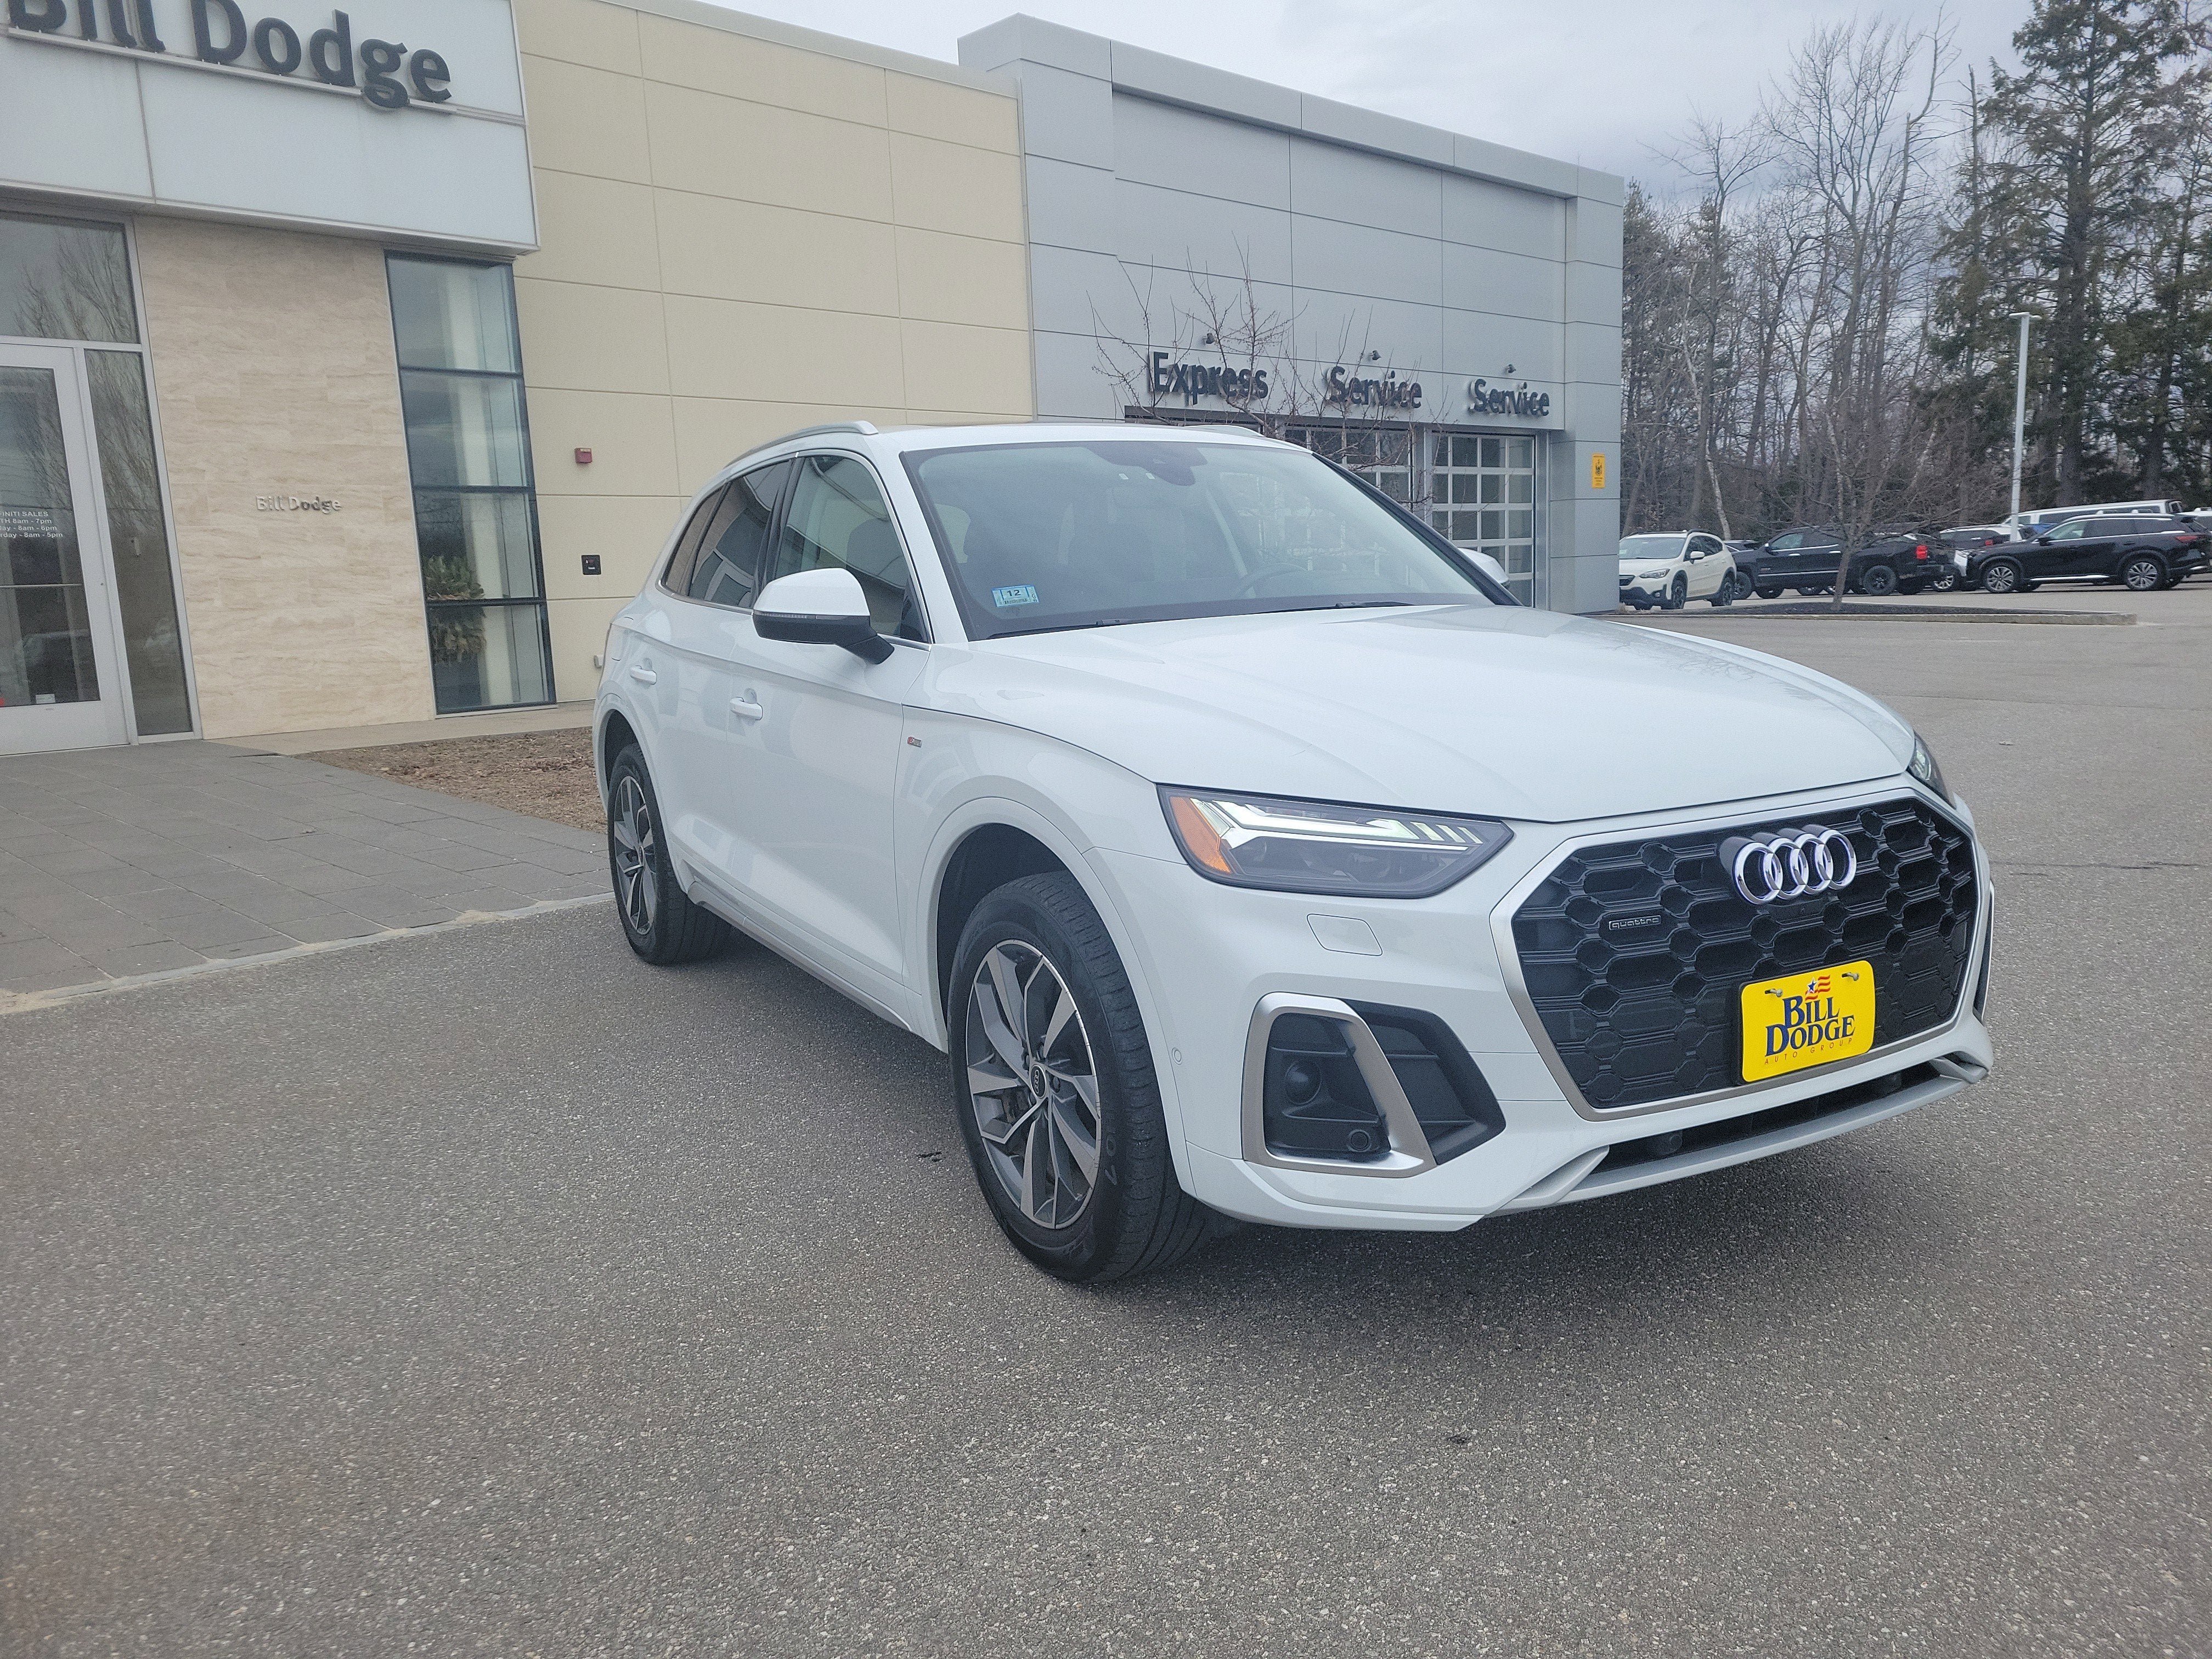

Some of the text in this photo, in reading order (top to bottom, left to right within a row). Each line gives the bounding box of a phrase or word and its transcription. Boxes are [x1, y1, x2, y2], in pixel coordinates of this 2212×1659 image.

[191, 0, 452, 109] Dodge
[1153, 351, 1550, 416] Express Service Service
[256, 495, 342, 515] Bill Dodge
[1612, 917, 1660, 929] quattro
[1782, 995, 1840, 1028] BILL
[1764, 1037, 1853, 1065] AUTO GROUP
[1765, 1015, 1856, 1057] DODGE
